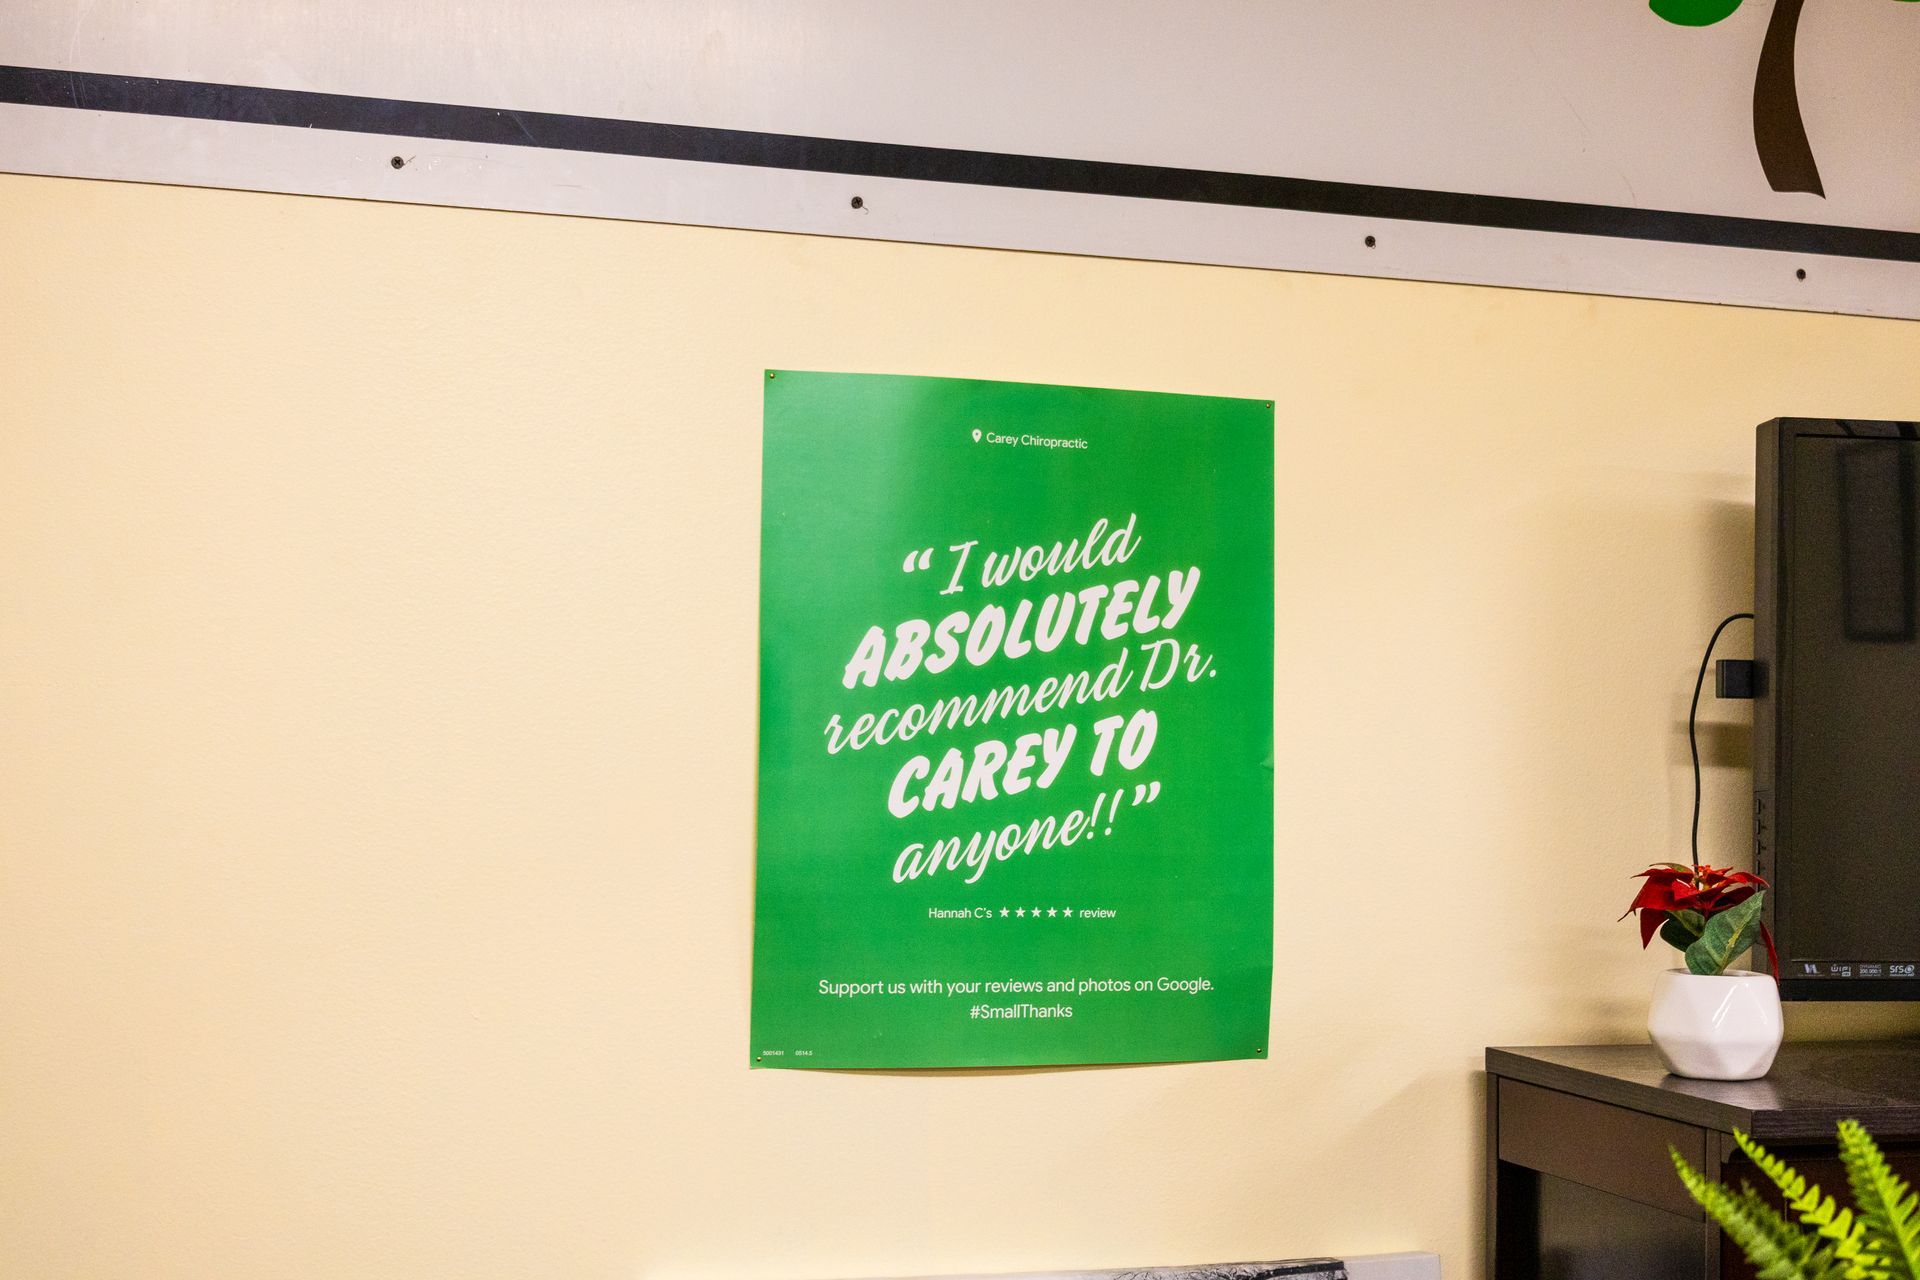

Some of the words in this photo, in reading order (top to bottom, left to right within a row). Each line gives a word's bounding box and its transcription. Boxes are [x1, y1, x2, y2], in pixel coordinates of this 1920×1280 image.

[986, 432, 1018, 447] Carey
[1021, 434, 1088, 449] Chiropractic
[981, 513, 1142, 588] would
[842, 566, 1201, 690] ABSOLUTELY
[823, 647, 1134, 755] recommend
[1139, 638, 1217, 692] Dr.
[887, 723, 1078, 819] CAREY
[1089, 708, 1158, 777] TO
[928, 907, 972, 919] Hannah
[1079, 907, 1117, 919] review
[818, 979, 884, 998] Support
[887, 983, 907, 996] us
[909, 979, 943, 995] with
[946, 982, 982, 998] your
[984, 978, 1044, 994] reviews
[1046, 978, 1075, 993] and
[1078, 977, 1131, 996] photos
[1134, 980, 1154, 993] on
[1156, 976, 1215, 995] Google.
[969, 1003, 1073, 1020] #SmallThanks
